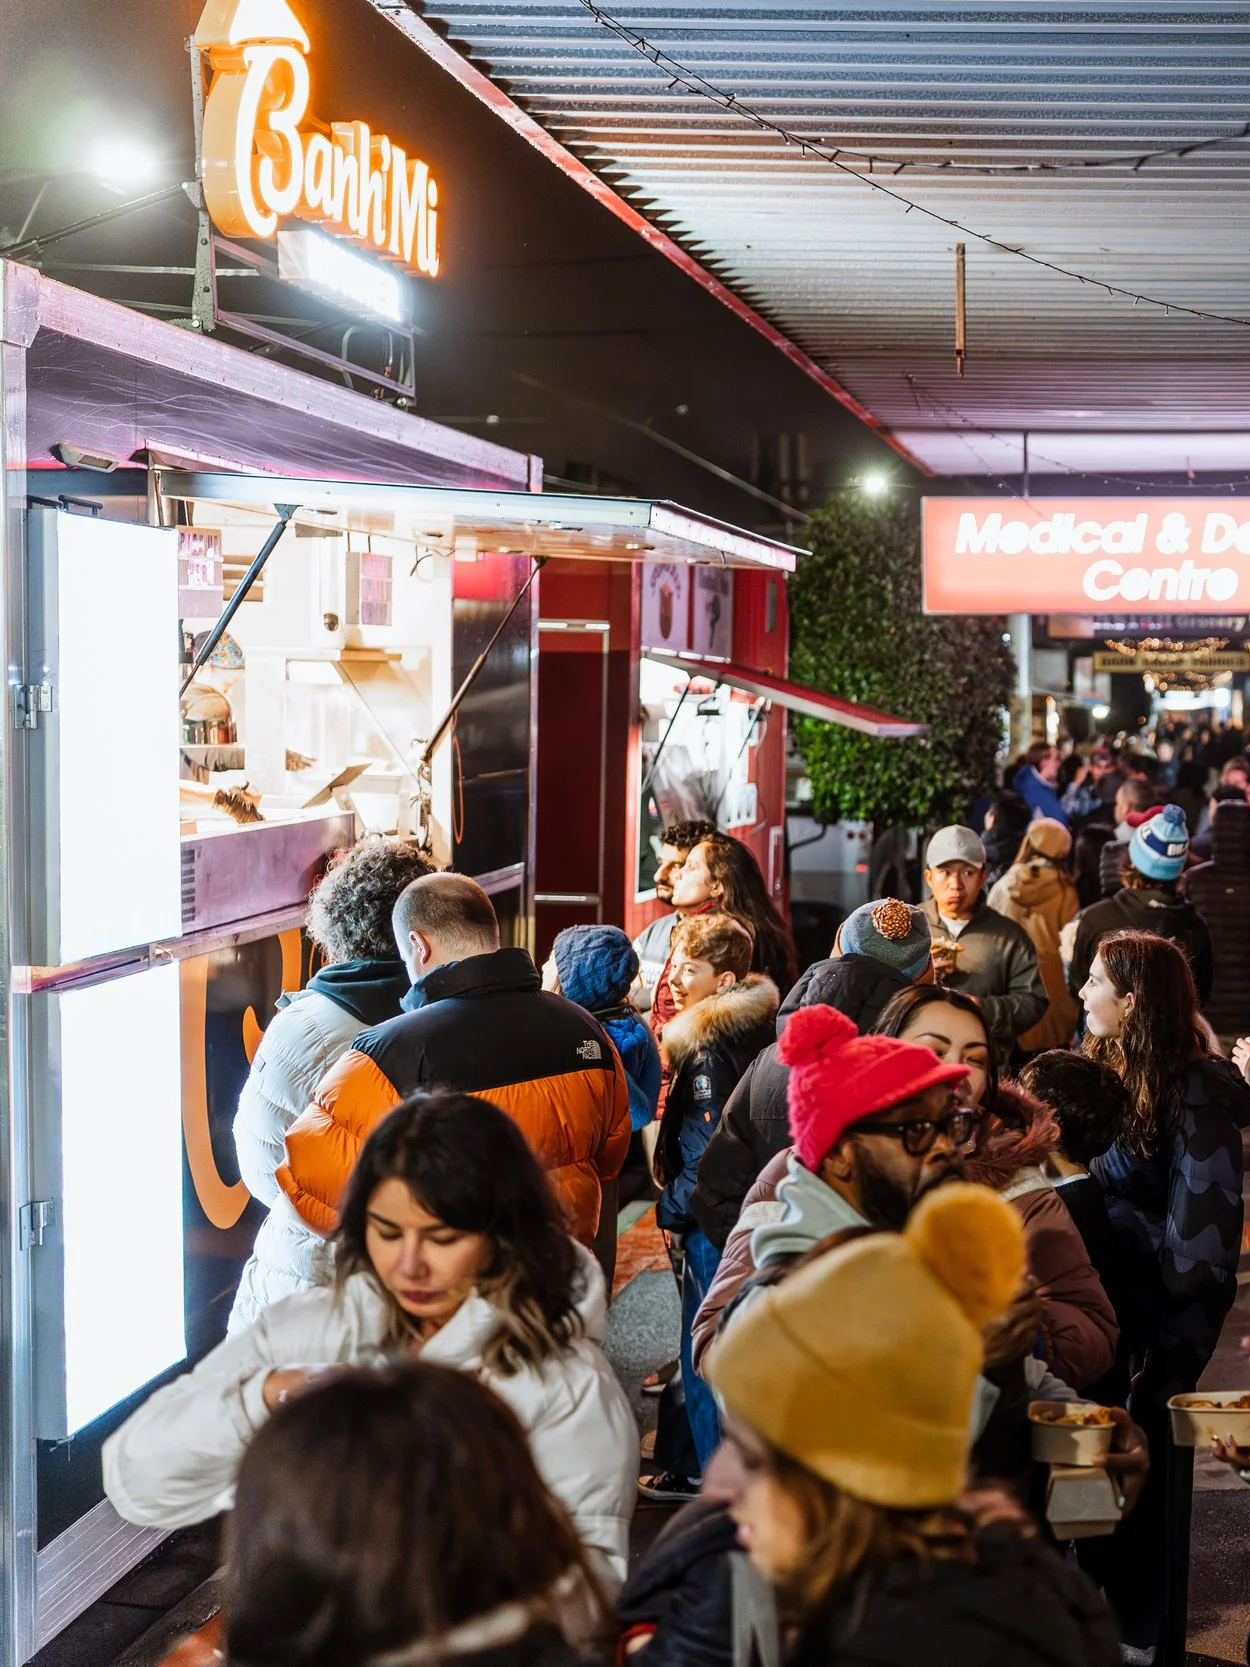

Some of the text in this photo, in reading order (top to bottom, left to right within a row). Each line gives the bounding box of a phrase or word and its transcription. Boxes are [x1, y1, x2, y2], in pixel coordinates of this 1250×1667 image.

[955, 513, 1147, 554] Medical
[1156, 513, 1191, 554] &
[1082, 560, 1239, 602] Centre
